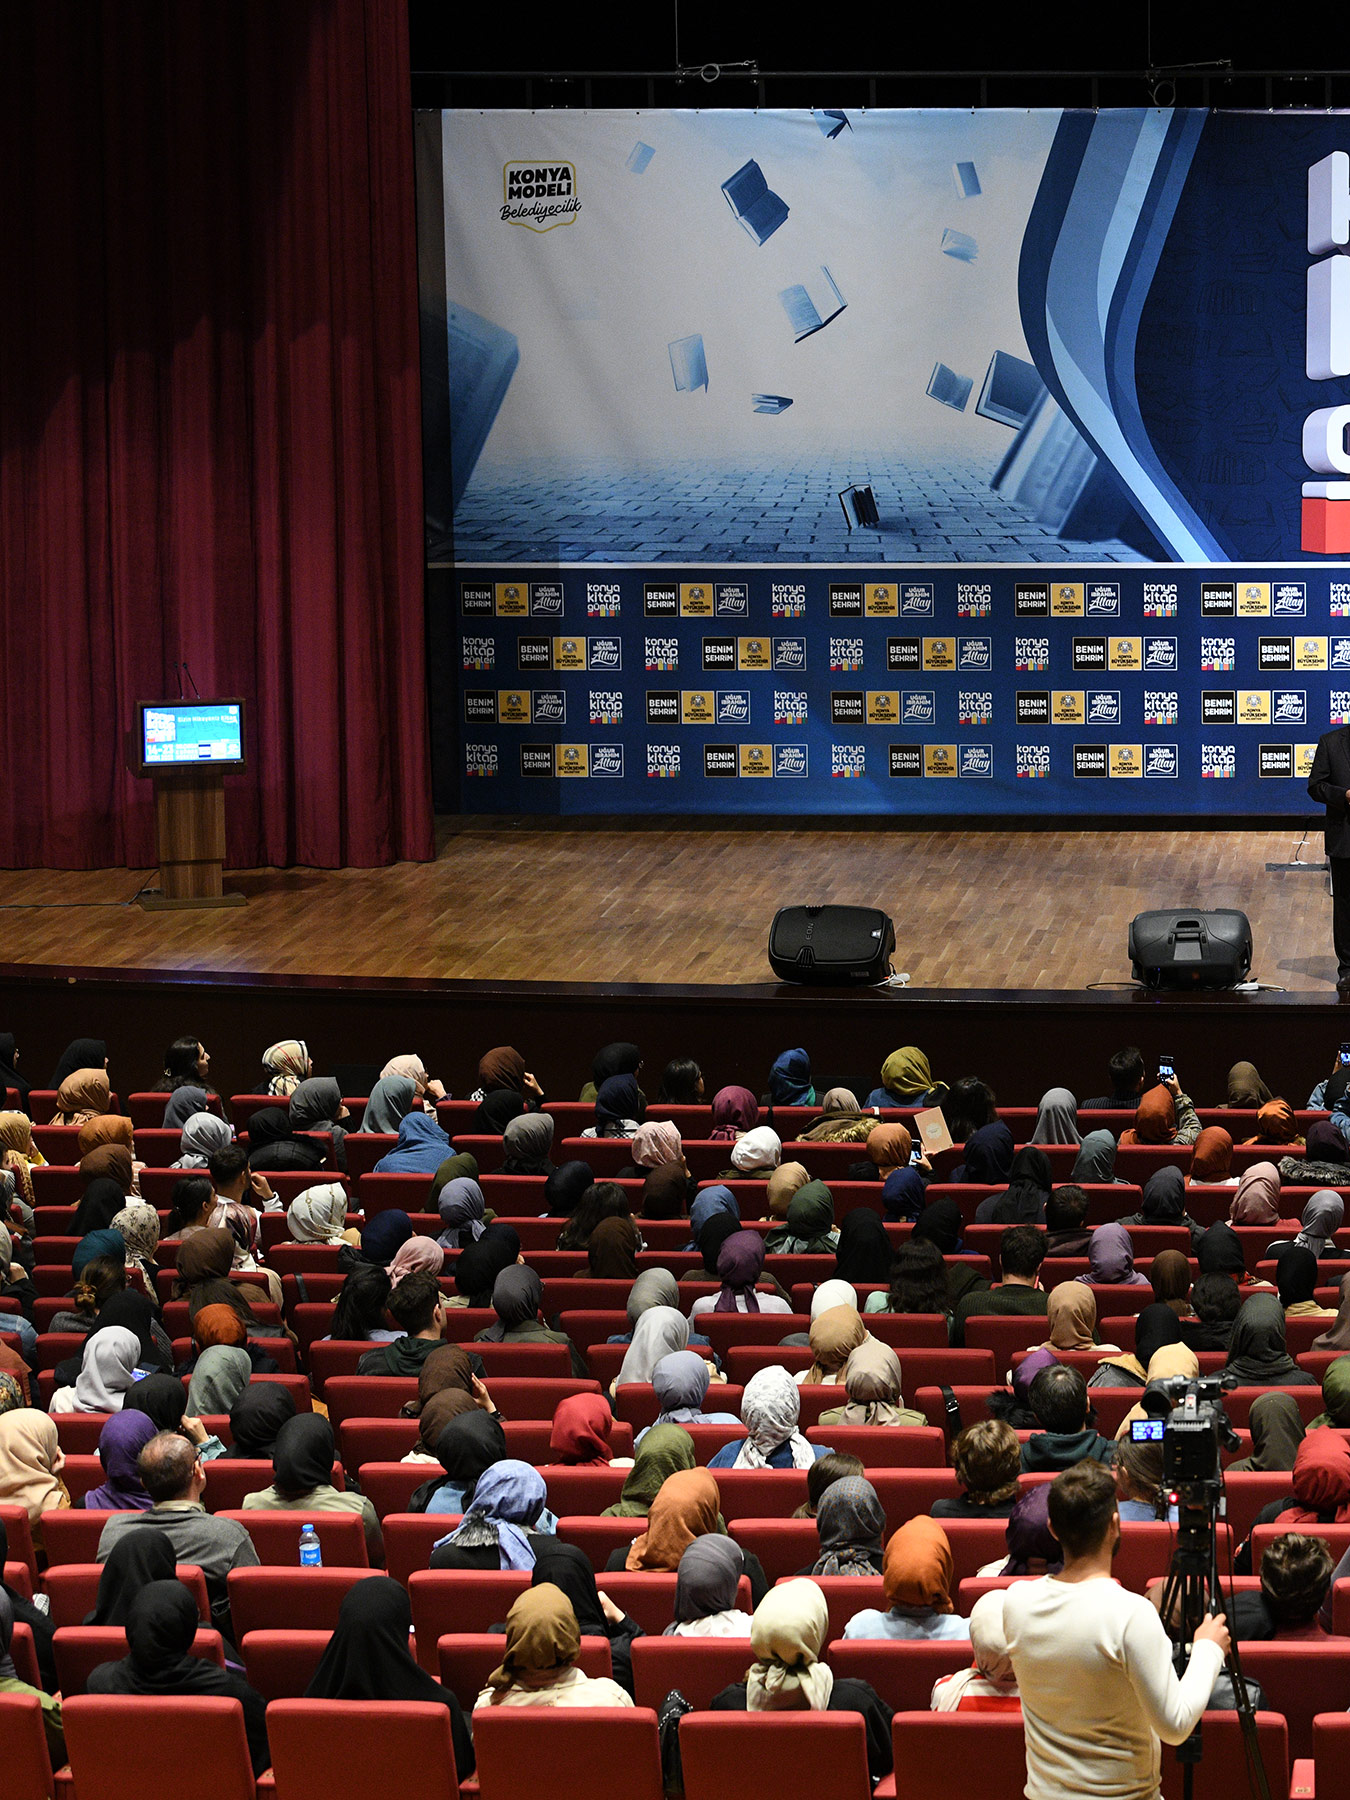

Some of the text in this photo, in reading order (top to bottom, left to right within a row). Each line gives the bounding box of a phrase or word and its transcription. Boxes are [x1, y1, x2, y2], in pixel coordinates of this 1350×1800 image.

[508, 167, 572, 185] KONYA
[499, 197, 582, 224] Belediyecilik
[587, 583, 620, 594] konya
[772, 583, 805, 594] konya
[958, 583, 991, 594] konya
[1144, 583, 1177, 594] konya
[588, 592, 620, 603] kitap
[773, 592, 805, 603] kitap
[958, 592, 990, 603] kitap
[1144, 592, 1177, 603] kitap
[645, 637, 678, 648] konya
[830, 637, 863, 648] konya
[1016, 637, 1048, 648] konya
[646, 646, 678, 657] kitap
[830, 646, 863, 657] kitap
[1016, 646, 1048, 657] kitap
[775, 690, 807, 701] konya
[959, 691, 992, 702] konya
[775, 699, 807, 710] kitap
[959, 700, 991, 711] kitap
[647, 744, 680, 755] konya
[832, 744, 865, 755] konya
[1017, 744, 1049, 755] konya
[1202, 744, 1235, 755] konya
[648, 753, 680, 764] kitap
[832, 753, 864, 764] kitap
[1017, 753, 1049, 764] kitap
[1202, 753, 1235, 764] kitap
[806, 922, 815, 940] EON
